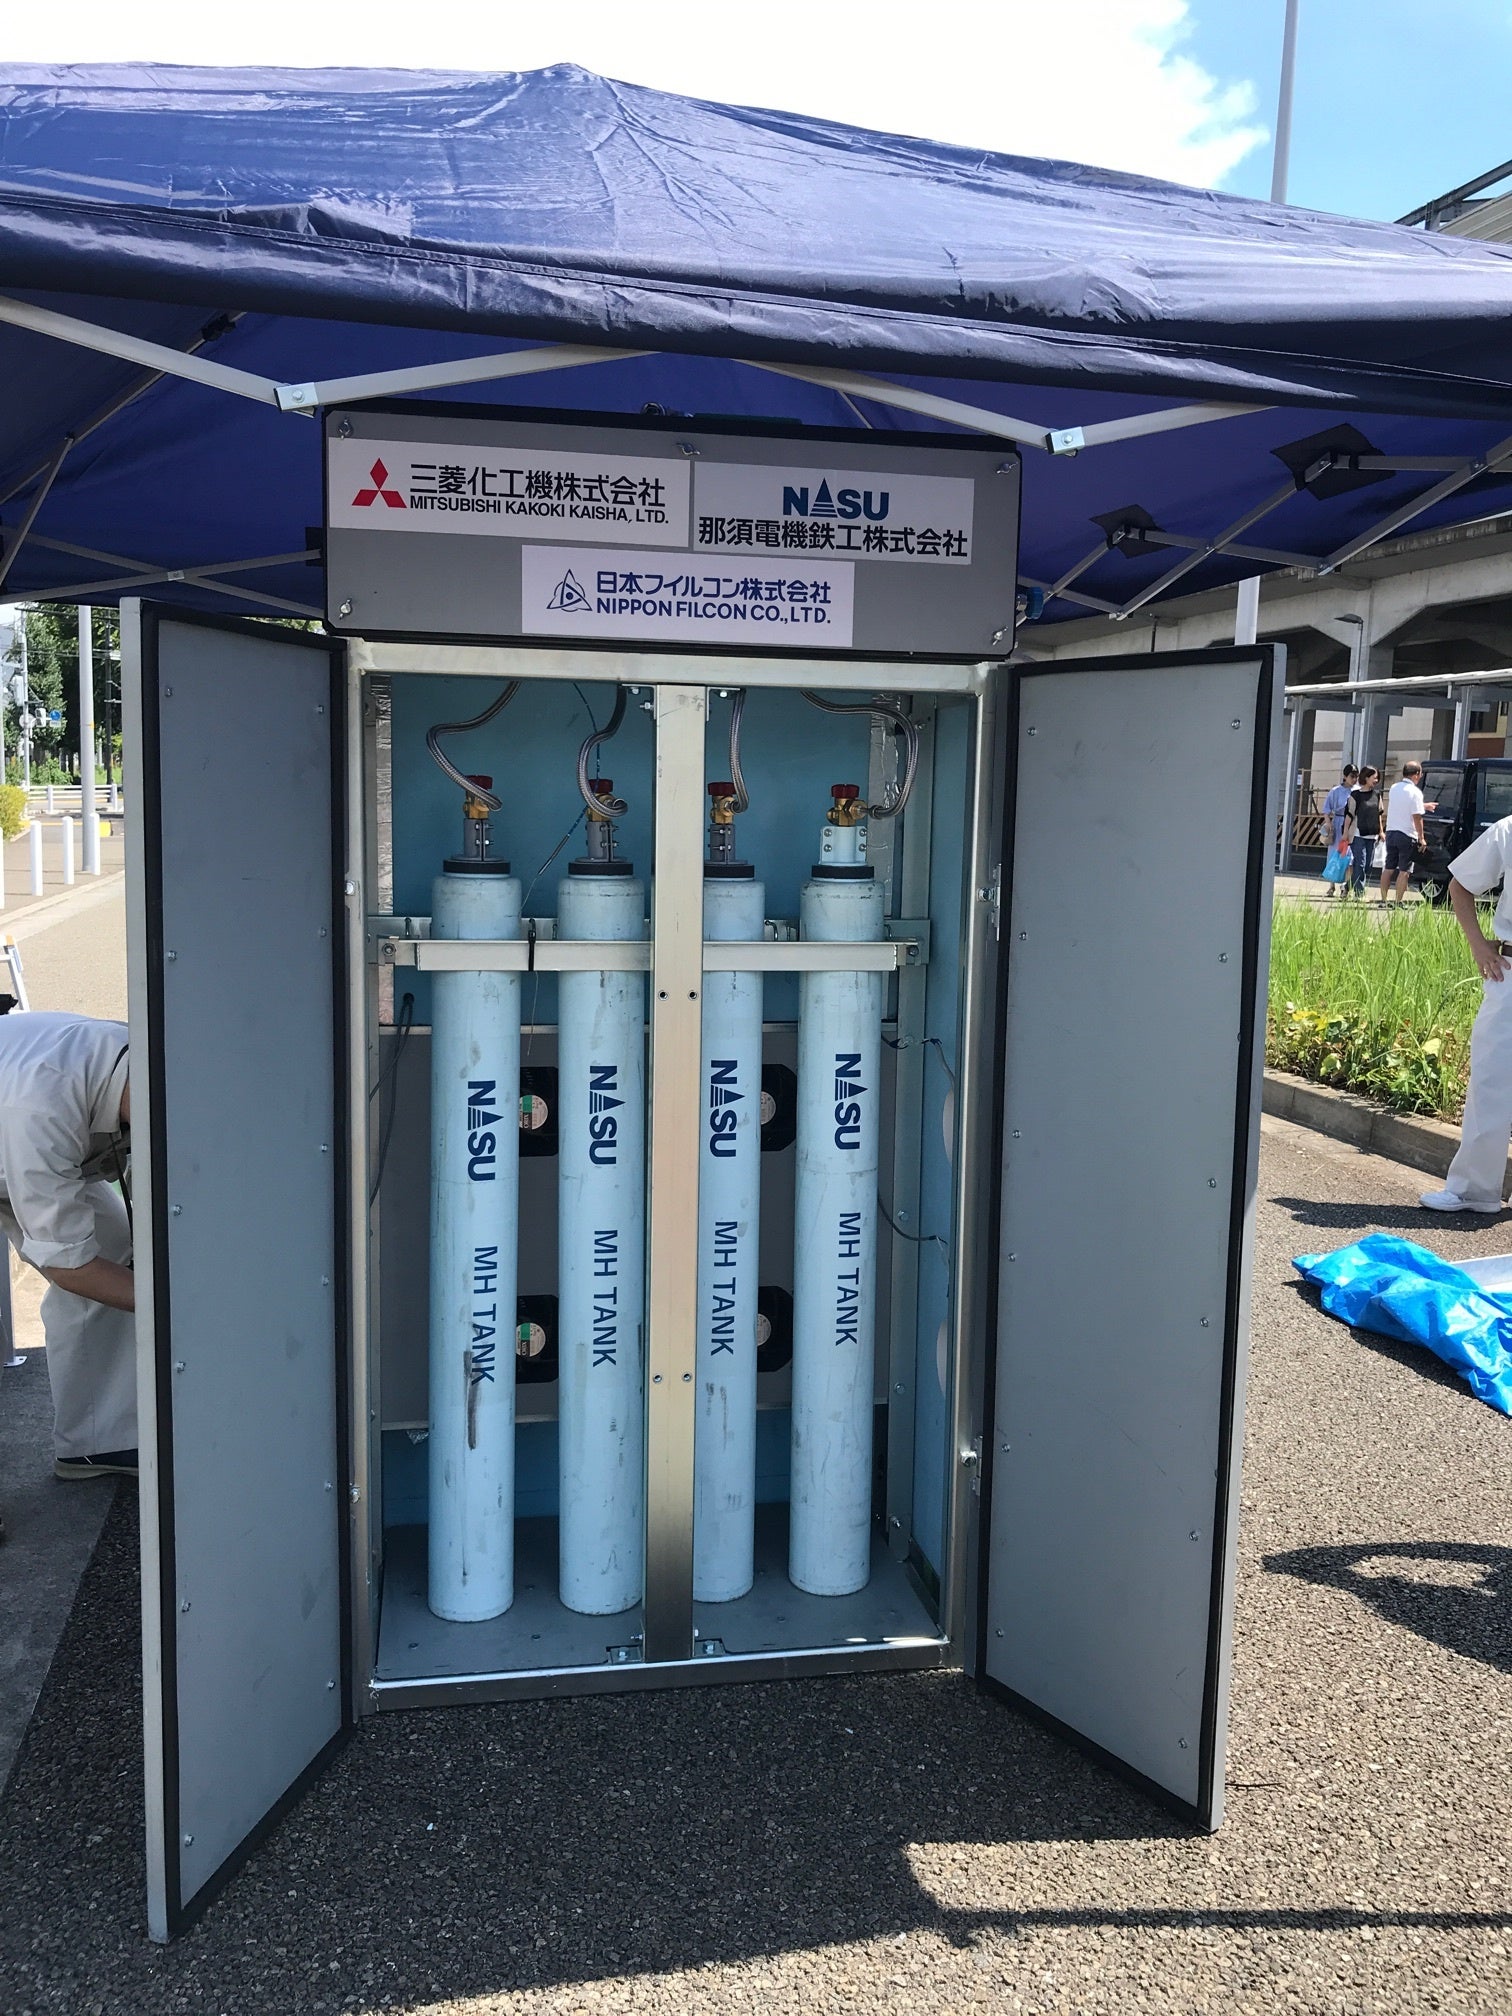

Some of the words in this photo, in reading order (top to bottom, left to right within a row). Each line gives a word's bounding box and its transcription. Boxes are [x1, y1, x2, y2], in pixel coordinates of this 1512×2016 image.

[410, 464, 666, 507] 三菱化工機株式会社
[783, 478, 889, 520] NASU
[410, 496, 500, 513] MITSUBISHI
[506, 501, 565, 517] KAKOKI
[569, 505, 633, 523] KAISHA,
[636, 509, 669, 524] LTD.
[699, 516, 968, 557] 那須電機鉄工株式会社
[597, 571, 831, 604] 日本フイルコン株式会社
[597, 598, 672, 617] NIPPON
[676, 601, 747, 620] FILCON
[589, 1066, 626, 1164] NASU
[710, 1060, 745, 1157] NASU
[835, 1054, 868, 1149] NASU
[468, 1081, 504, 1181] NASU
[594, 1230, 618, 1276] MH
[714, 1222, 738, 1267] MH
[839, 1213, 861, 1257] MH
[474, 1246, 498, 1294] MH
[593, 1287, 617, 1367] TANK
[711, 1277, 736, 1356] TANK
[836, 1268, 859, 1346] TANK
[471, 1303, 497, 1385] TANK
